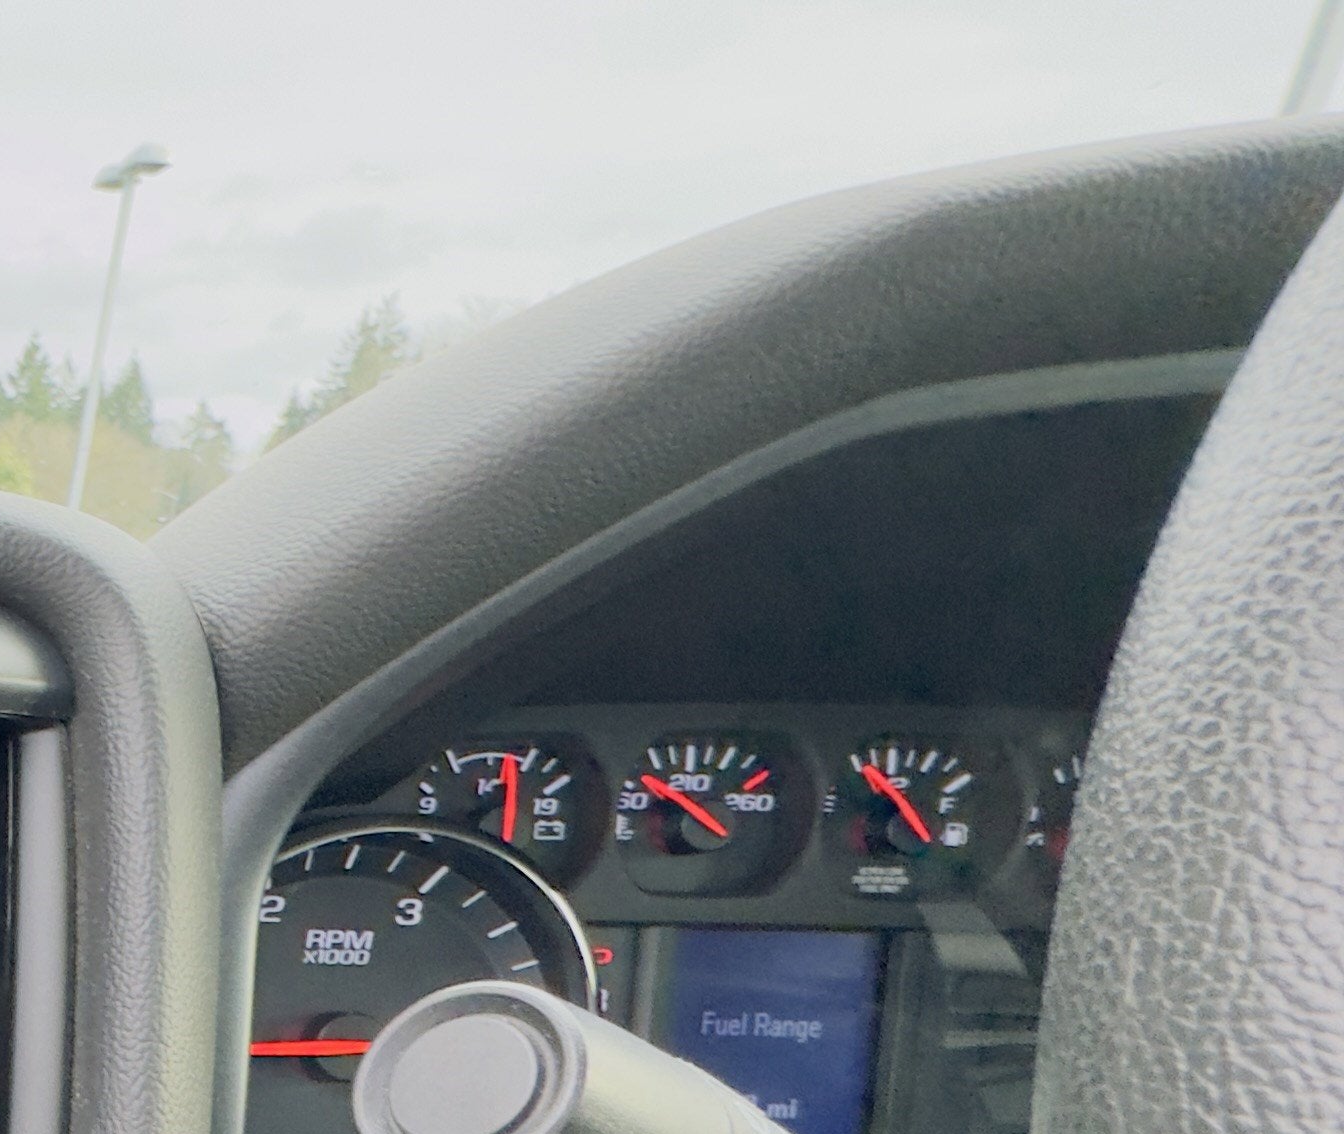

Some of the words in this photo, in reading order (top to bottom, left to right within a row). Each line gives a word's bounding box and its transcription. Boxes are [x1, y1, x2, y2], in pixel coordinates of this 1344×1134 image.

[668, 774, 711, 792] 210
[418, 797, 437, 814] 9
[533, 798, 559, 815] 19
[723, 793, 775, 811] 260
[939, 797, 957, 814] F
[259, 895, 286, 923] 2
[394, 898, 423, 926] 3
[305, 929, 375, 950] RPM
[700, 1011, 748, 1036] Fuel
[753, 1012, 823, 1043] Range
[766, 1098, 797, 1119] mi
